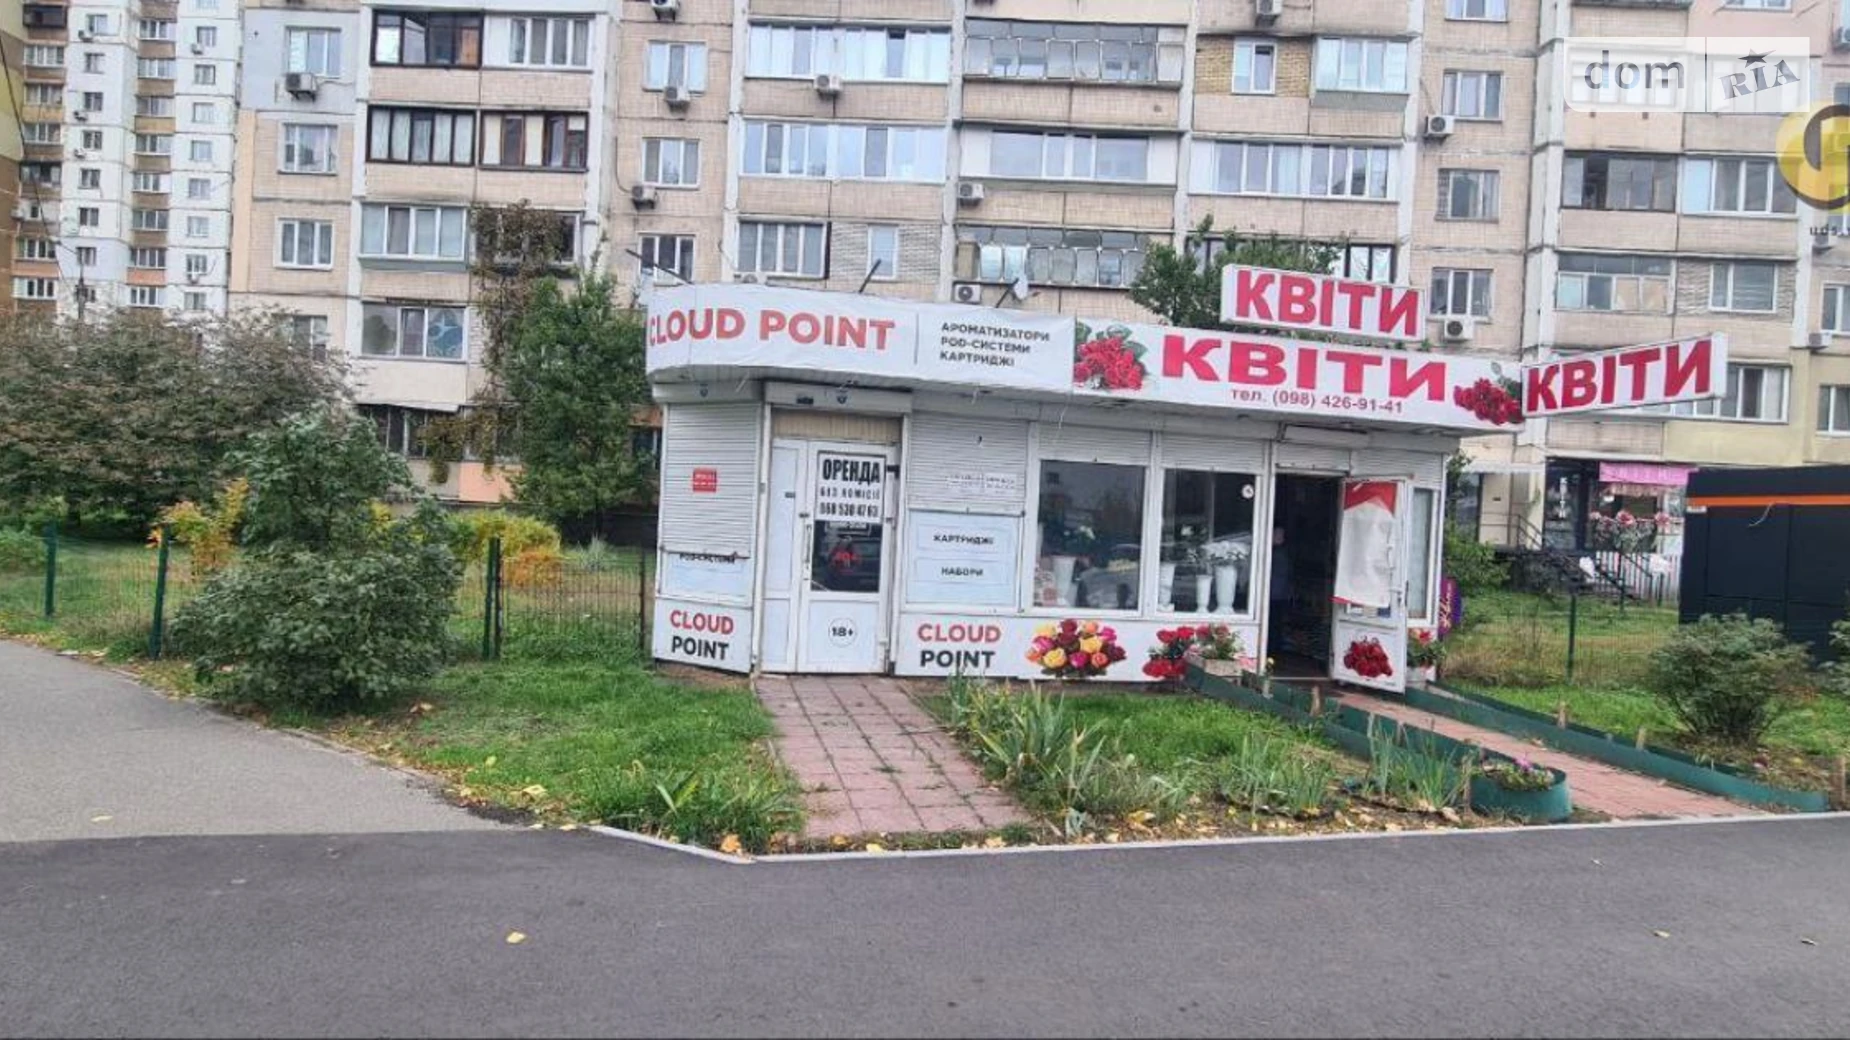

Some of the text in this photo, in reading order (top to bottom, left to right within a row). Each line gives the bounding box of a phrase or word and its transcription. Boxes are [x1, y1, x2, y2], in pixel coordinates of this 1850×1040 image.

[1235, 269, 1420, 337] КВІТИ
[650, 308, 896, 350] CLOUD POINT
[941, 322, 1050, 342] АРОМАТИЗАТОРИ
[940, 351, 1015, 368] КАРТРИДЖІ
[1162, 335, 1447, 402] КВІТИ
[1527, 340, 1711, 412] КВІТИ
[1231, 389, 1404, 413] тел. (098) 426-91-41
[822, 459, 880, 484] ОРЕНДА
[934, 534, 995, 546] КАРТРИДЖІ
[941, 566, 984, 577] НАБОРИ
[670, 609, 734, 636] CLOUD
[831, 627, 854, 637] 18+
[917, 623, 1002, 644] CLOUD
[671, 635, 730, 661] POINT
[920, 650, 996, 669] POINT
